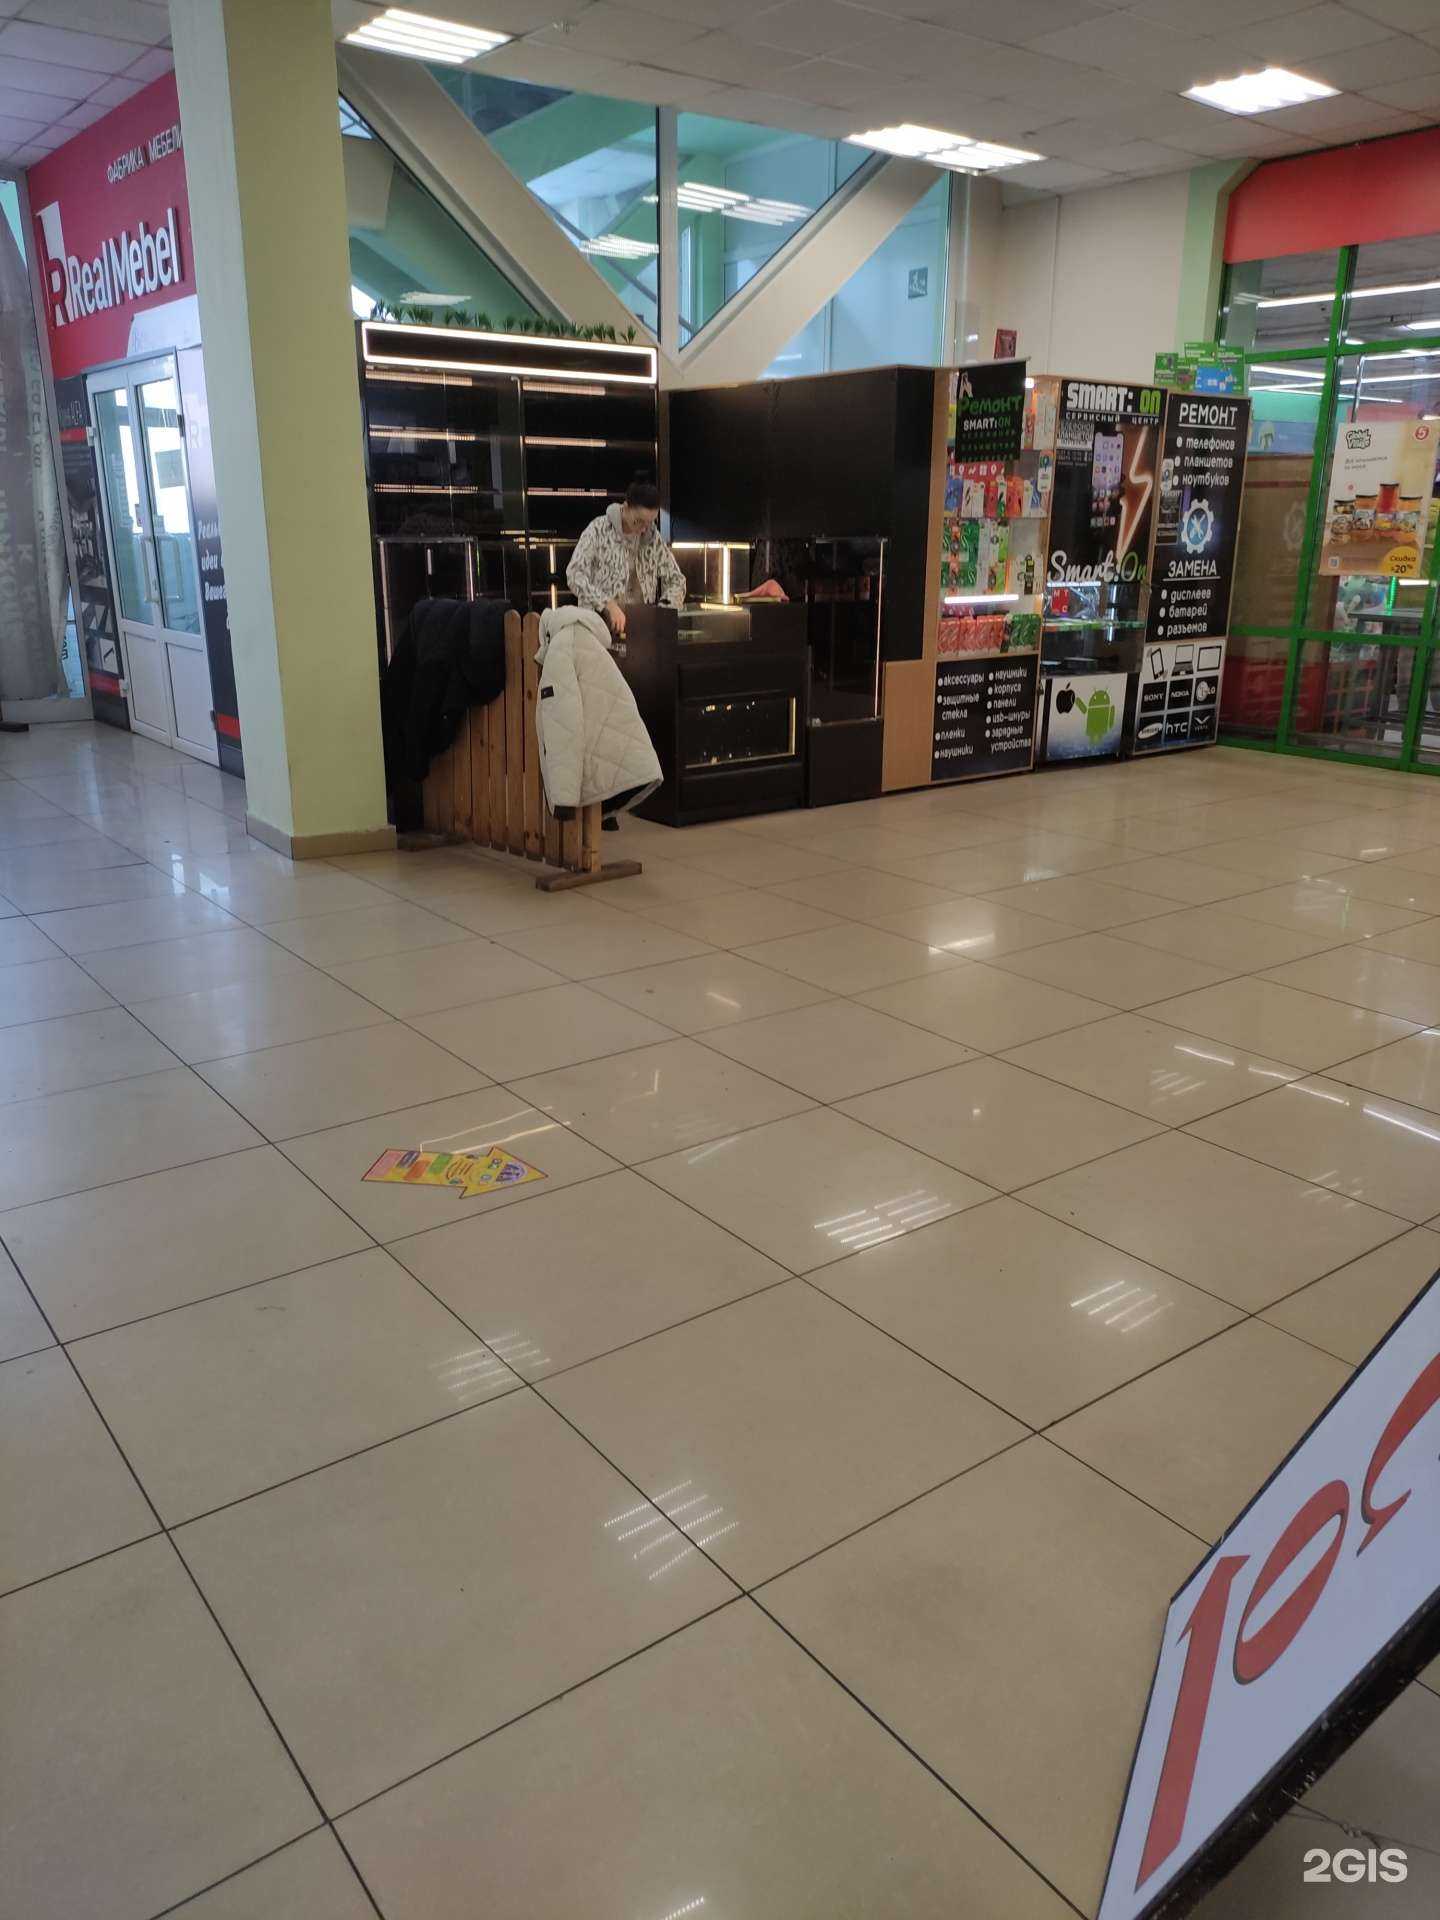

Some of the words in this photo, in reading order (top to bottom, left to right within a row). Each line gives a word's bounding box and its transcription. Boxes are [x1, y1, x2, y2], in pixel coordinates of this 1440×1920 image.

[107, 147, 144, 183] ФАБРИКА
[1066, 411, 1120, 422] СЕРВИСНЫЙ
[1179, 403, 1238, 426] РЕМОНТ
[1185, 435, 1235, 452] телефонов
[1184, 456, 1233, 468] планшетов
[1182, 472, 1230, 488] ноутбуков
[1168, 559, 1217, 577] ЗАМЕНА
[1170, 588, 1212, 604] дисплеев
[1169, 603, 1208, 619] батарей
[1166, 622, 1208, 638] разъемов
[943, 672, 984, 687] аксессуары
[995, 666, 1028, 681] наушники
[994, 682, 1022, 696] корпуса
[1170, 690, 1190, 698] NOKIA
[942, 692, 980, 707] защитные
[993, 698, 1017, 709] панели
[1143, 693, 1164, 702] SONY
[941, 708, 968, 720] стекла
[940, 728, 966, 741] пленки
[991, 725, 1024, 738] зарядные
[940, 744, 974, 759] наушники
[990, 738, 1031, 753] устройства
